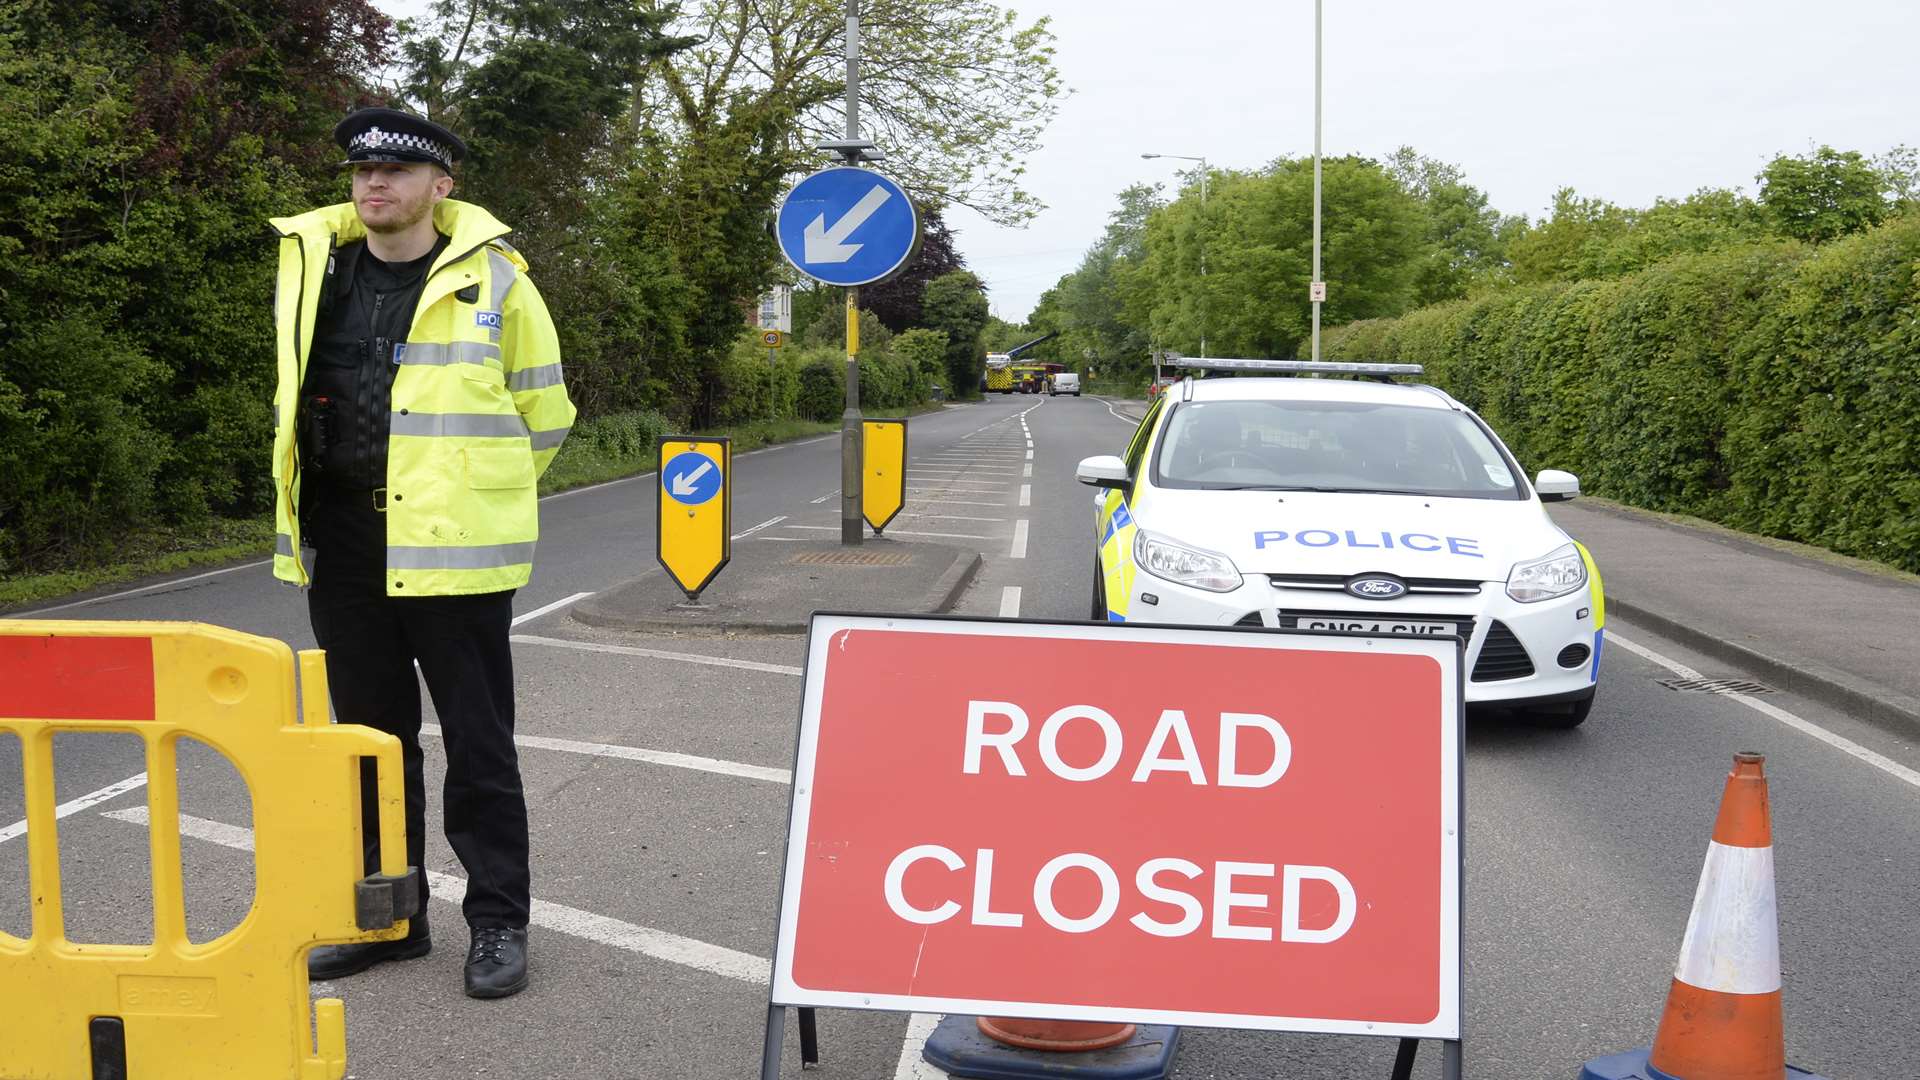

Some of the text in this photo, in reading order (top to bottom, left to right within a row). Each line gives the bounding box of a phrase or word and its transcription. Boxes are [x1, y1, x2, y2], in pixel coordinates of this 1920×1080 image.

[1255, 530, 1483, 557] POLICE
[1362, 582, 1392, 593] Ford
[963, 701, 1291, 787] ROAD
[885, 845, 1356, 943] CLOSED
[127, 987, 215, 1012] amey
